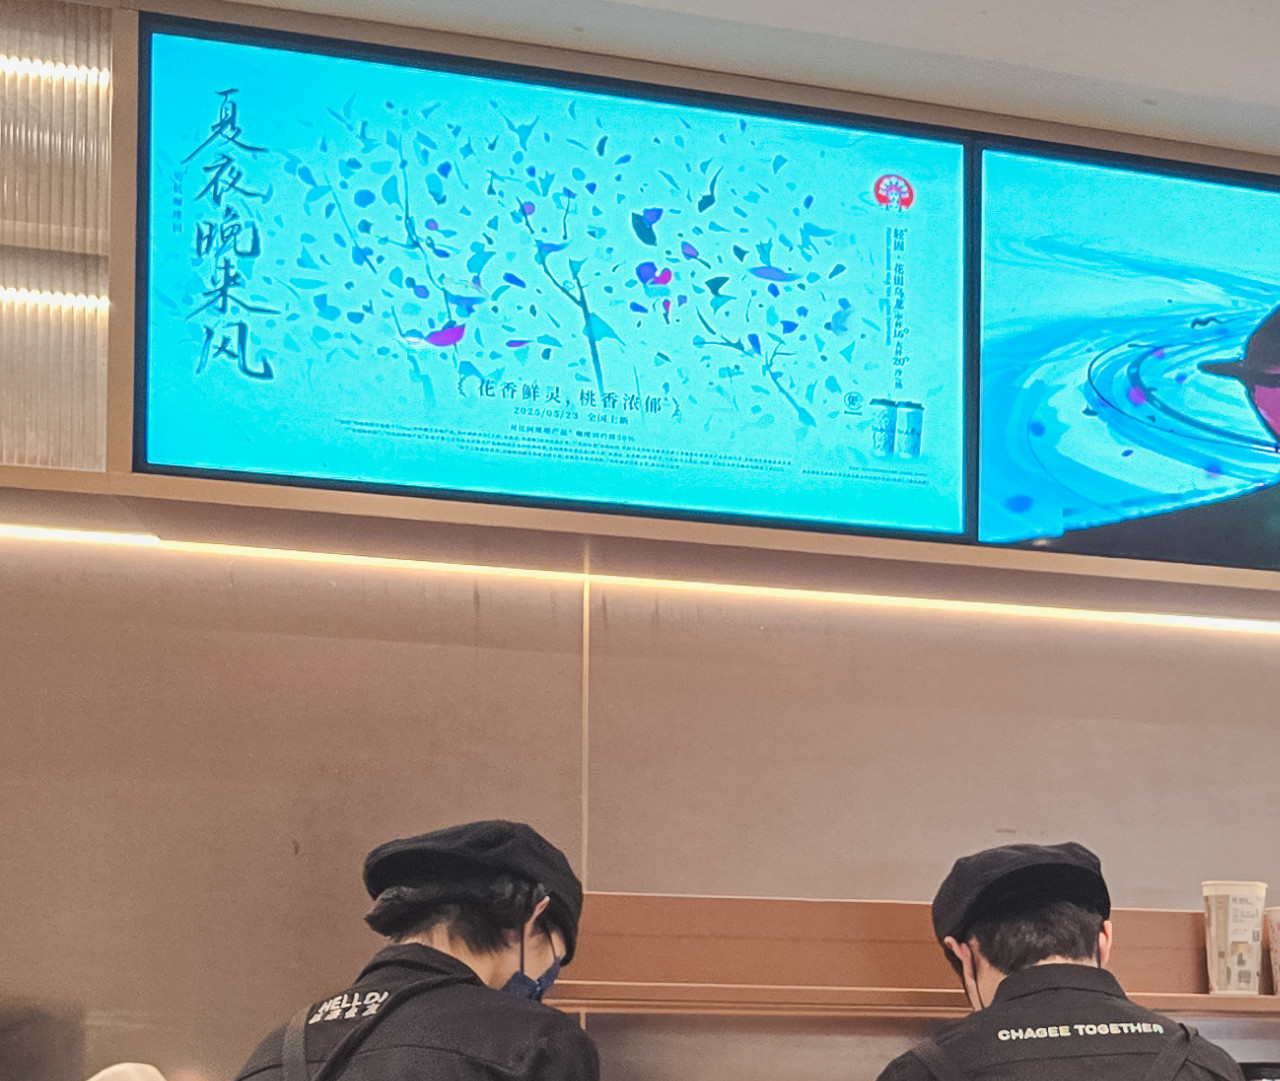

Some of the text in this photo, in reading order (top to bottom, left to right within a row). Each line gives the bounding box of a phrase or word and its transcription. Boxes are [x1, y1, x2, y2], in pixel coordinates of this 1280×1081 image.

[180, 87, 281, 381] 夏夜晚来风
[997, 1022, 1165, 1041] CHAGEE TOGETHER
